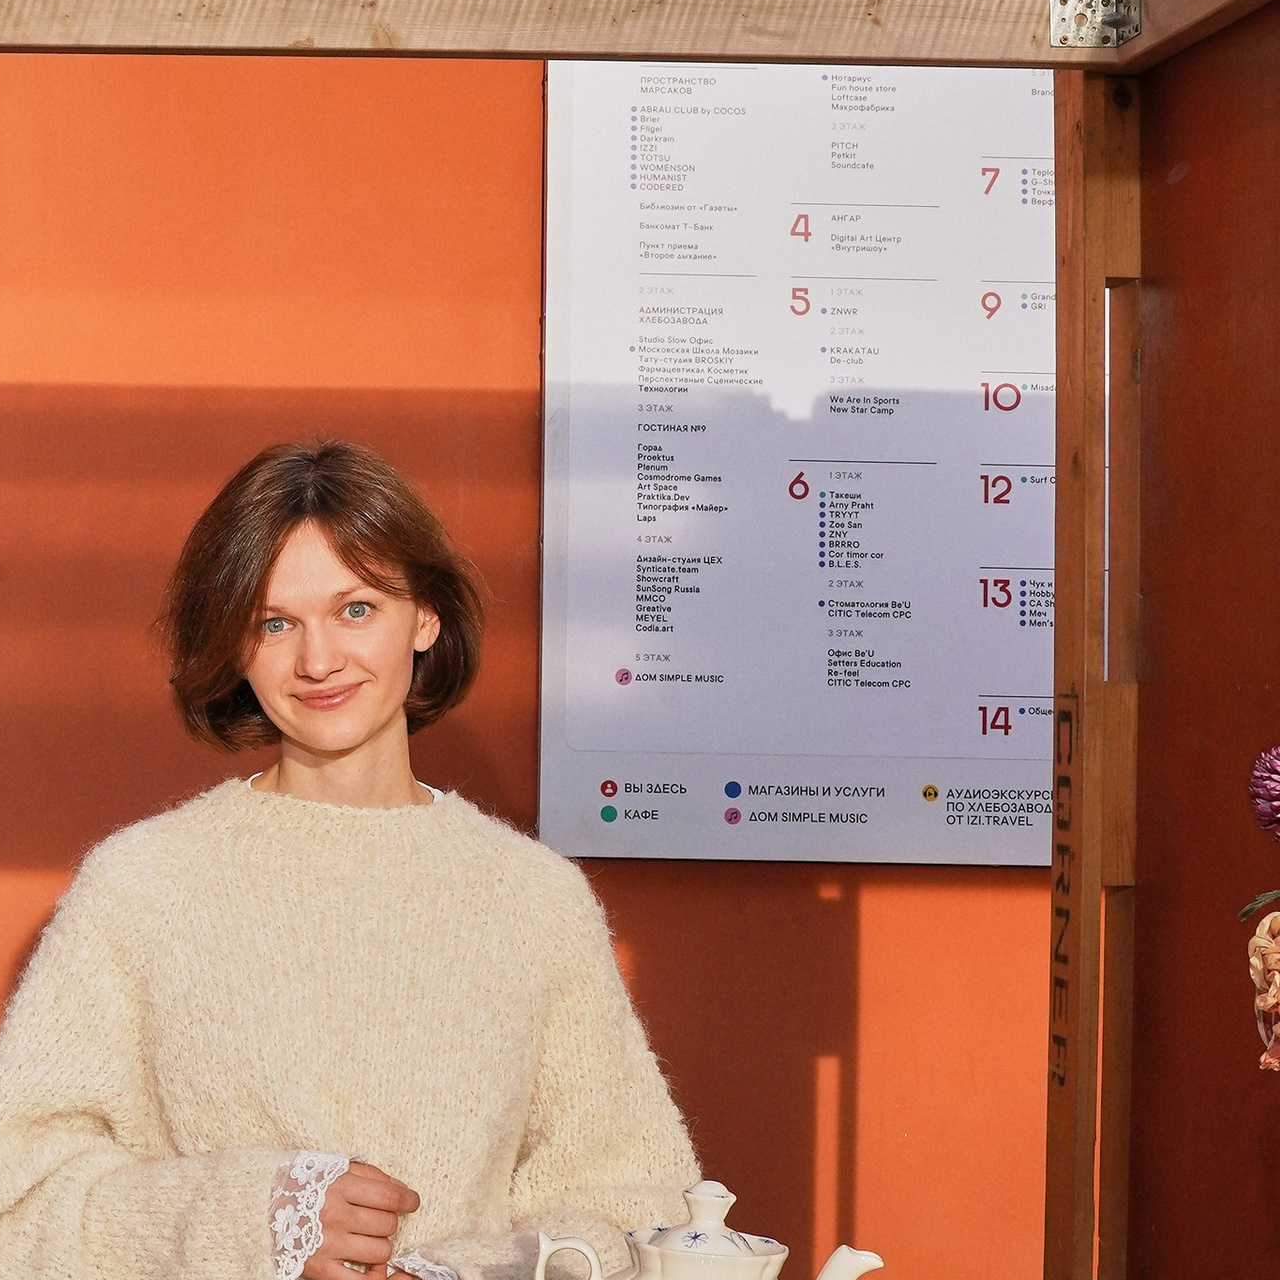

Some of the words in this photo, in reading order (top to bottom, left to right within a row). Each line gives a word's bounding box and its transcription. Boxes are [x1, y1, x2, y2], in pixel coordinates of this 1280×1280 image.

[641, 77, 716, 85] ПРОСТРАНСТВО
[640, 164, 695, 172] WOMENSON
[982, 168, 999, 195] 7
[791, 214, 811, 242] 4
[831, 234, 856, 244] Digital
[790, 288, 810, 315] 5
[982, 292, 1001, 319] 9
[640, 307, 723, 317] АДМИНИСТРАЦИЯ
[689, 337, 712, 345] Офис
[639, 346, 689, 354] Московская
[831, 347, 879, 355] KRAKATAU
[639, 355, 692, 364] Тату-студия
[638, 375, 704, 385] Перспективные
[872, 397, 899, 406] Sports
[982, 383, 1021, 411] 10
[870, 407, 894, 415] Camp
[638, 424, 688, 432] ГОСТИНАЯ
[638, 463, 668, 471] Plenum
[638, 473, 691, 482] Cosmodrome
[789, 472, 809, 499] 6
[981, 475, 1011, 504] 12
[637, 503, 688, 512] Типография
[692, 504, 728, 513] «Майер»
[829, 502, 849, 511] Arny
[637, 515, 656, 523] Laps
[637, 555, 701, 565] Дизайн-студия
[704, 557, 722, 565] ЦЕХ
[636, 585, 671, 595] SunSong
[980, 579, 1011, 607] 13
[636, 614, 667, 622] MEYEL
[855, 610, 890, 618] Telecom
[660, 674, 692, 682] SIMPLE
[892, 680, 910, 688] CPC
[979, 707, 1011, 735] 14
[625, 783, 642, 793] ВЫ
[647, 784, 686, 793] ЗДЕСЬ
[749, 786, 818, 796] МАГАЗИНЫ
[823, 787, 830, 796] И
[834, 787, 884, 797] УСЛУГИ
[947, 802, 964, 812] ПО
[625, 810, 658, 819] КАФЕ
[749, 812, 777, 821] ДОМ
[782, 812, 825, 822] SIMPLE
[830, 813, 867, 823] MUSIC
[947, 815, 963, 825] ОТ
[968, 816, 1033, 826] IZI.TRAVEL
